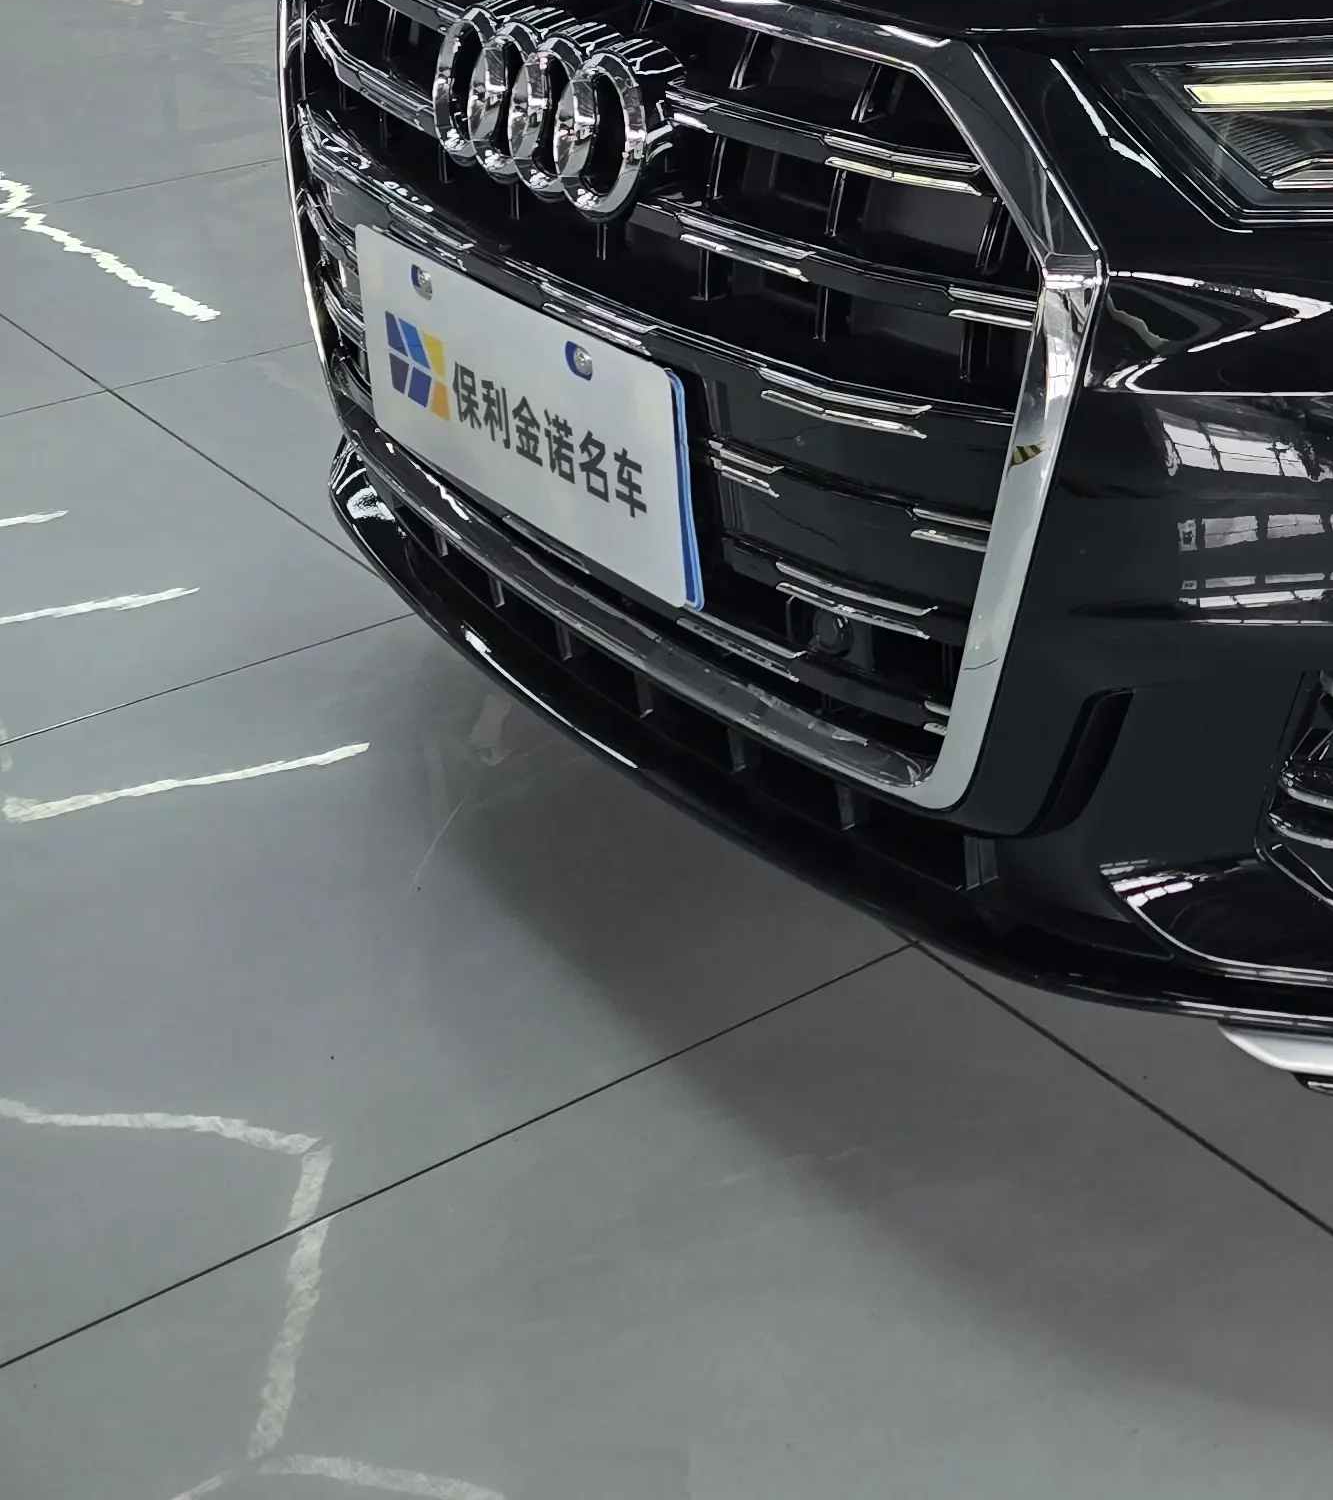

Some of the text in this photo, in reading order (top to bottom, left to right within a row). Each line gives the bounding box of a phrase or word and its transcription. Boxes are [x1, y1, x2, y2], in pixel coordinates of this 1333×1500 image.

[452, 360, 648, 519] 保利金诺名车
